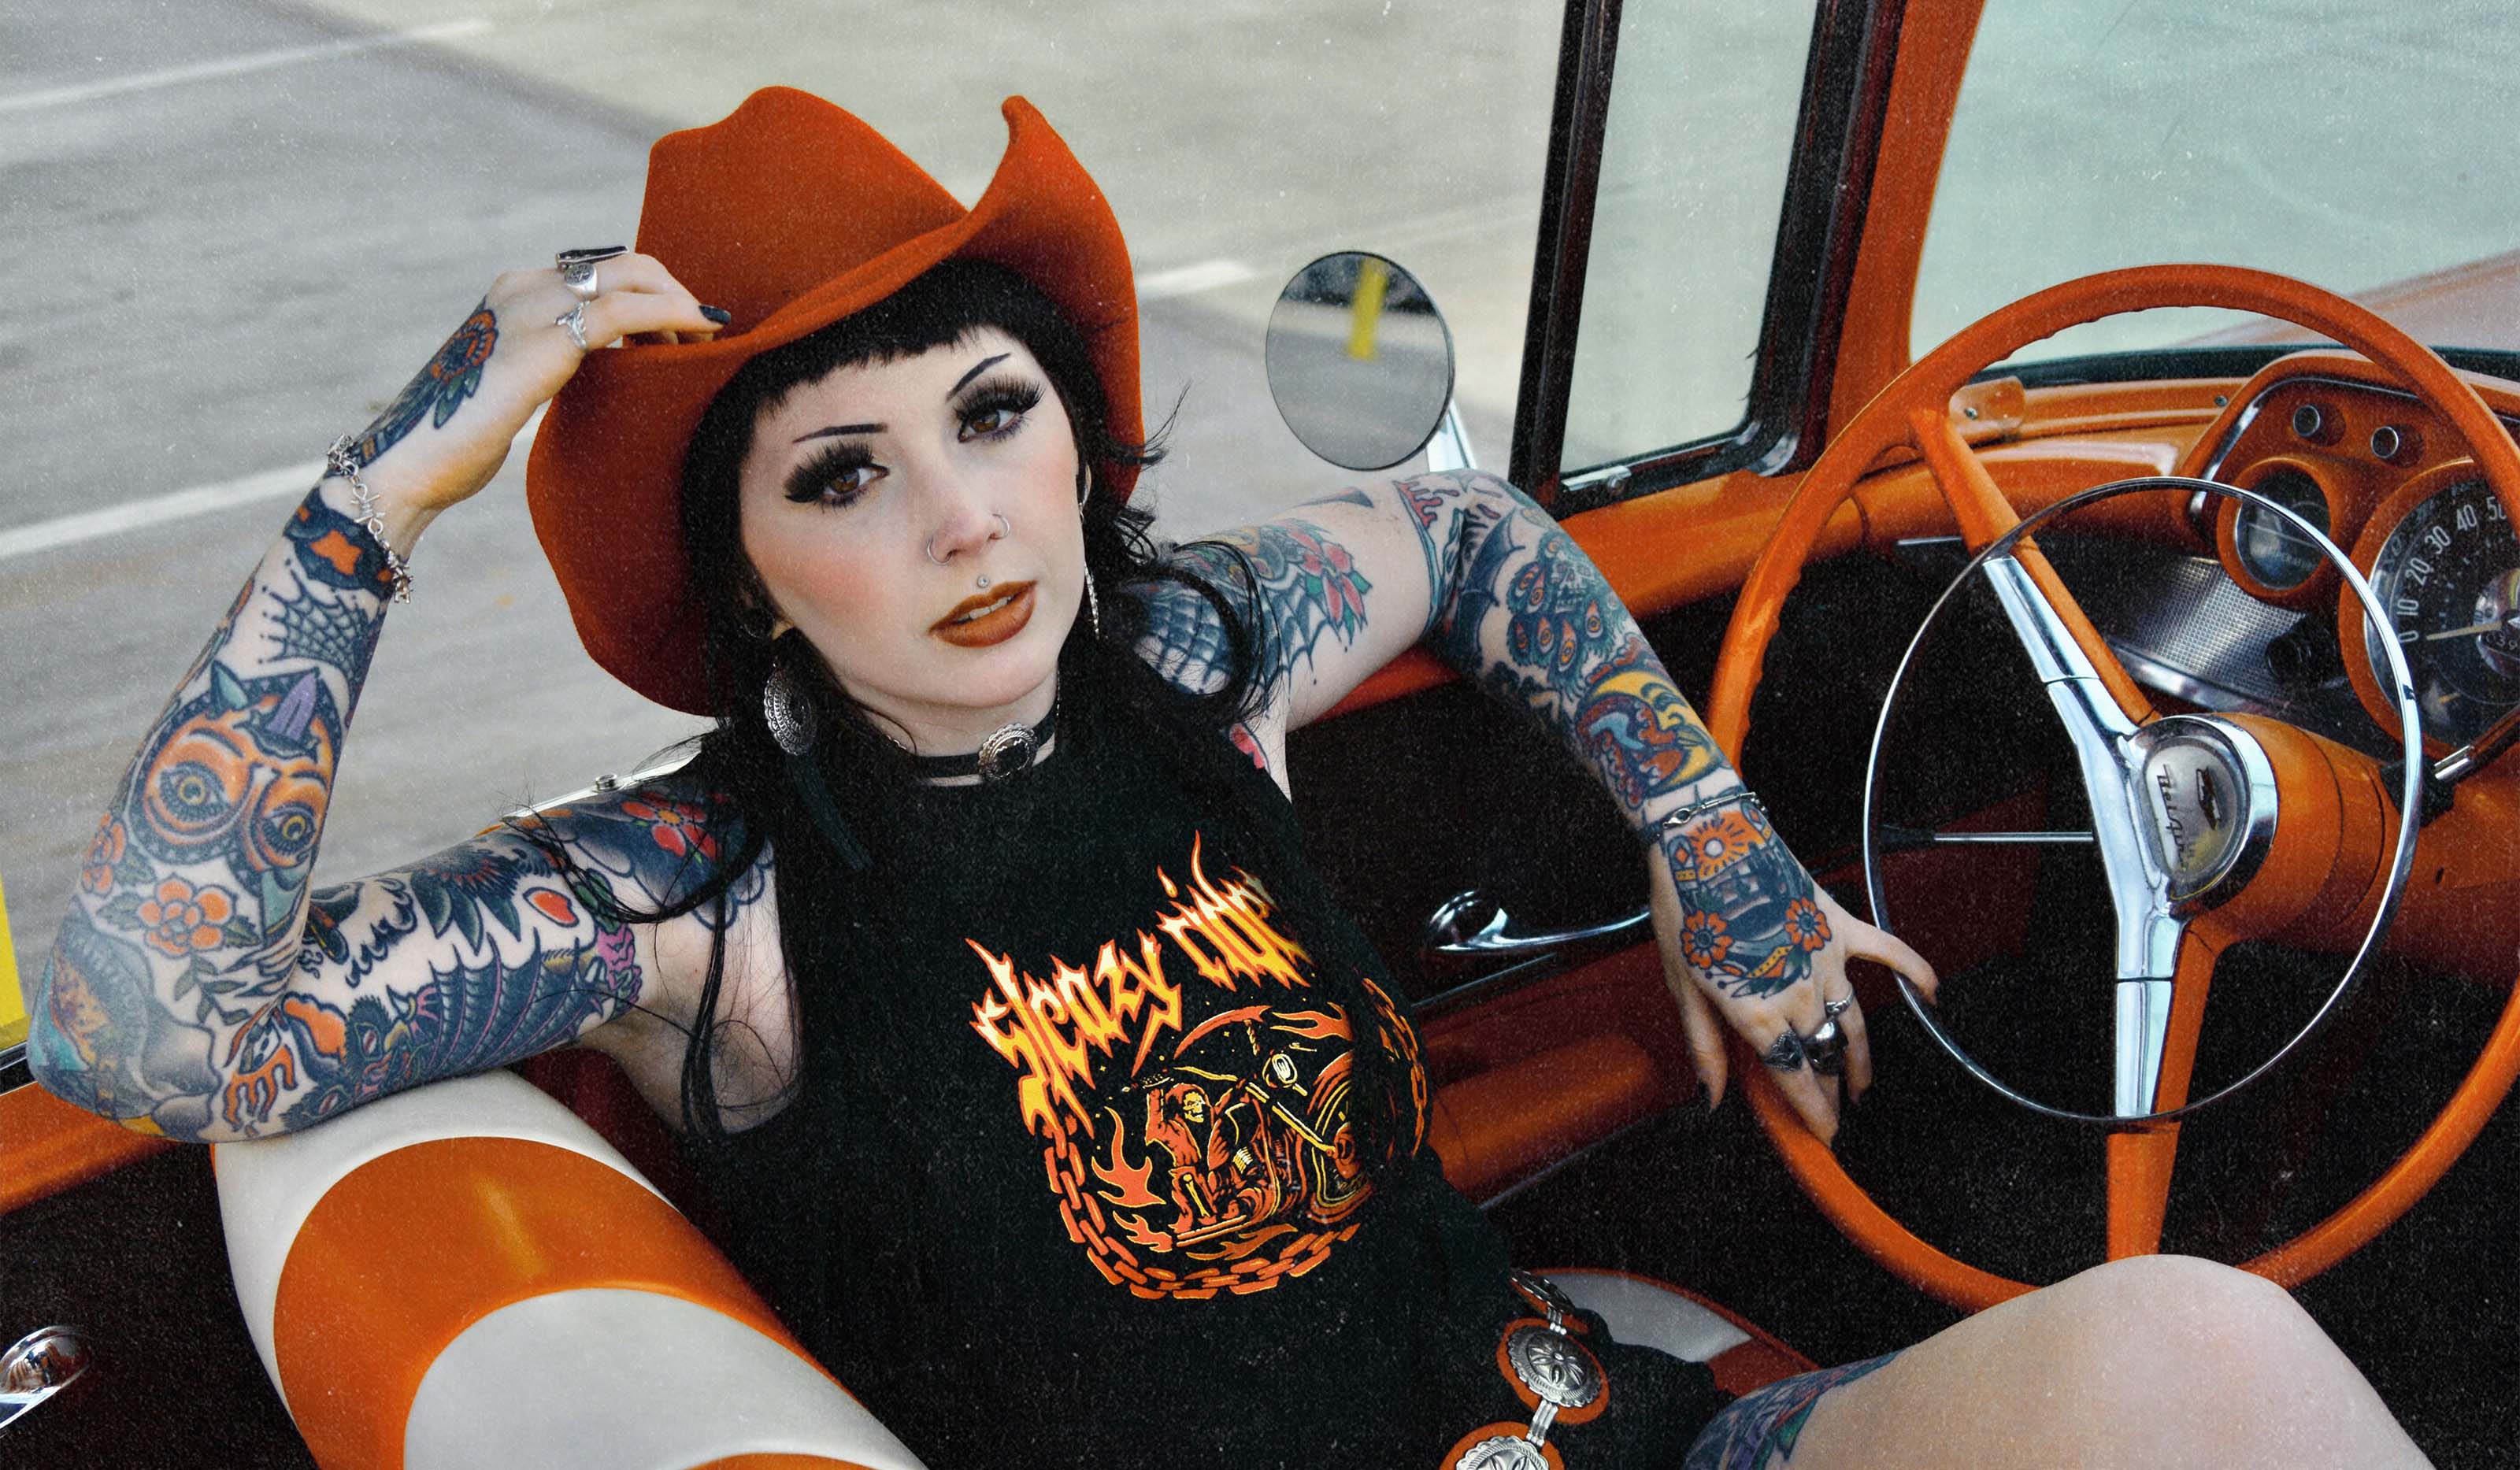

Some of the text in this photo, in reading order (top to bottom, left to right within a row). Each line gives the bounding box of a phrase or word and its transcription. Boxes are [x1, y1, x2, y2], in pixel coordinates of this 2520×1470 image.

[2455, 503, 2478, 532] 40
[2424, 525, 2451, 555] 30
[2404, 557, 2432, 586] 20
[2396, 598, 2419, 617] 10
[2397, 630, 2419, 643] 0
[2157, 764, 2177, 810] Bel
